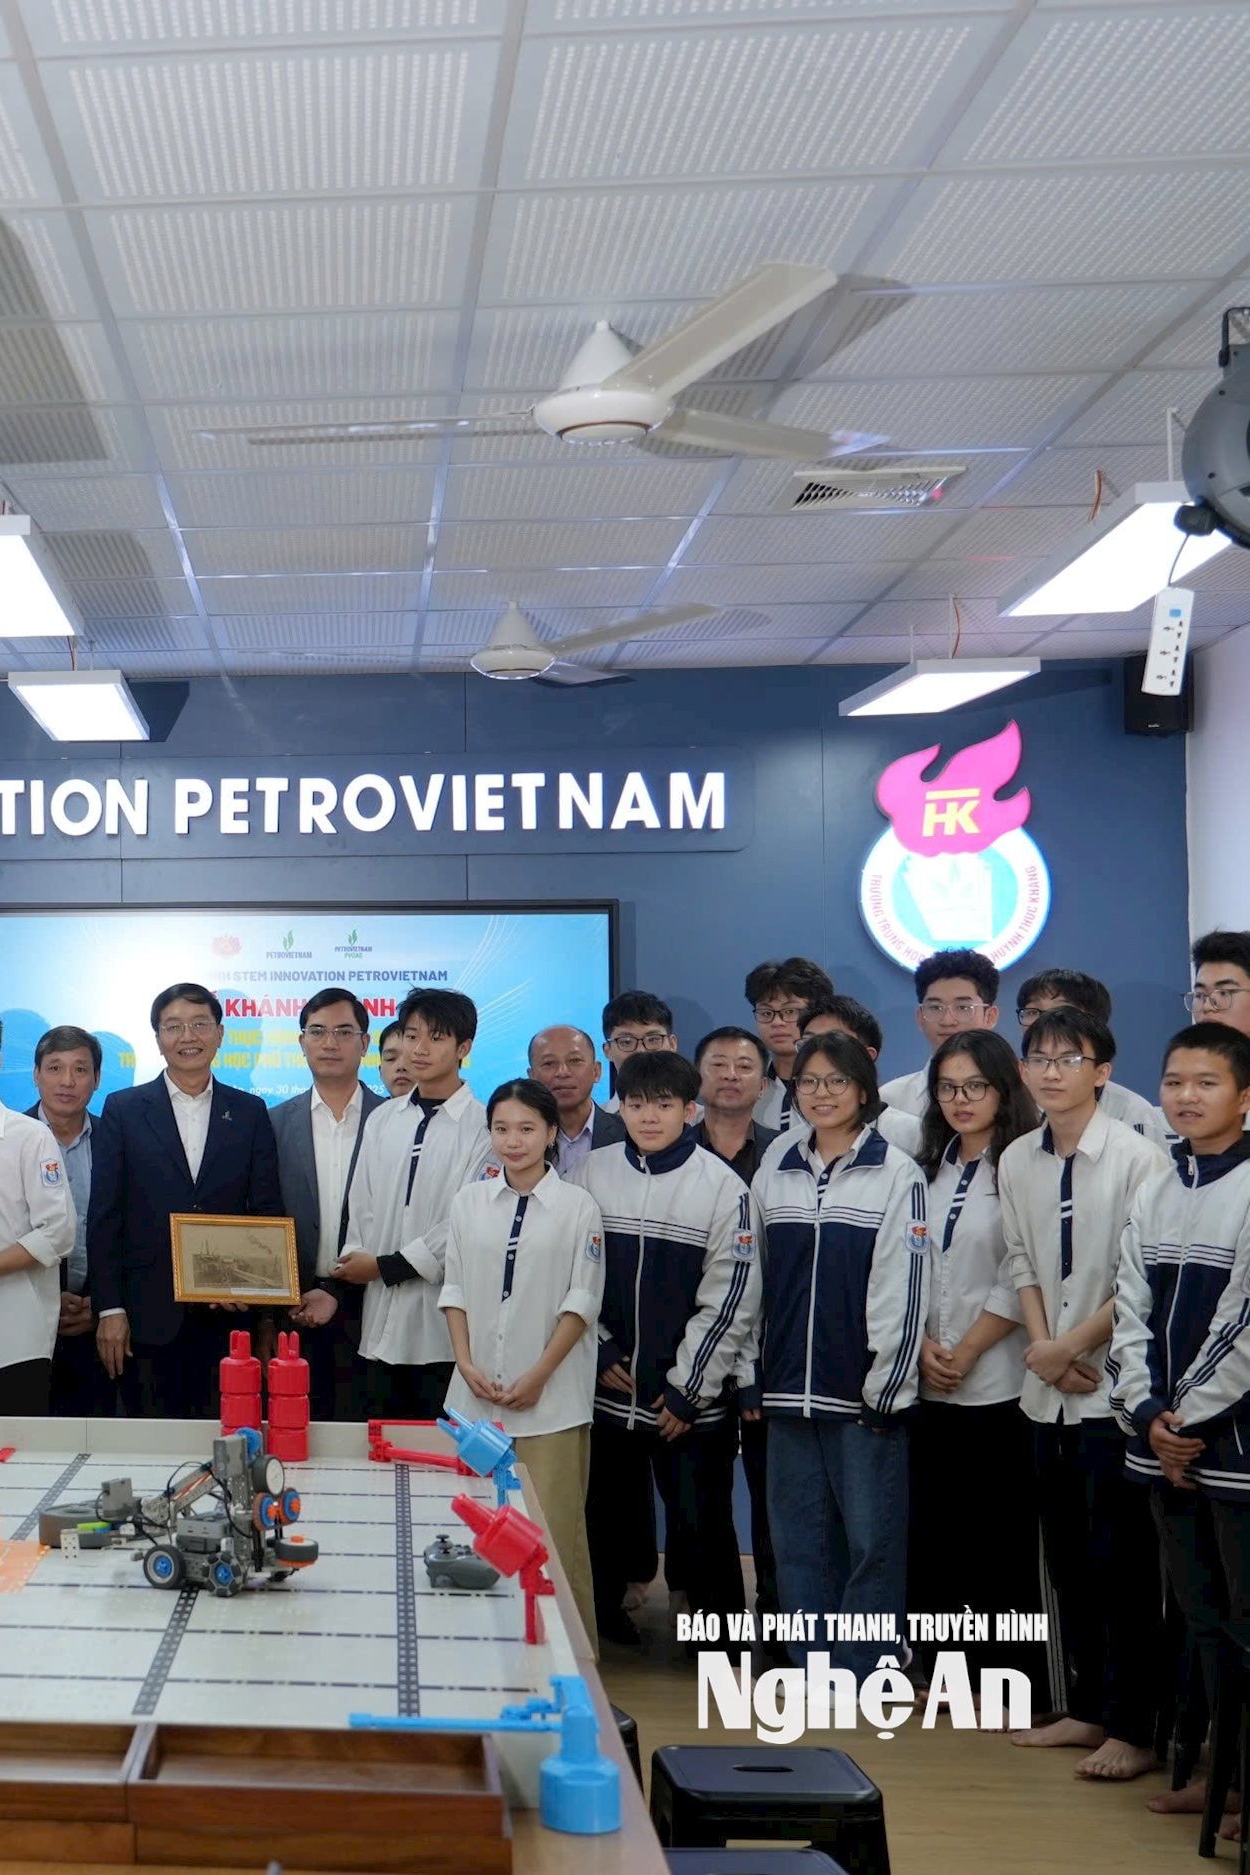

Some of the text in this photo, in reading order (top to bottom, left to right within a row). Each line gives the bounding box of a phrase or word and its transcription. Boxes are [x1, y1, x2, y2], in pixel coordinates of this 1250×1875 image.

[174, 772, 726, 835] PETROVIETNAM
[266, 951, 312, 959] PETROVIETNAM
[233, 971, 268, 982] STEM
[270, 971, 345, 982] INNOVATION
[350, 970, 448, 981] PETROVIETNAM
